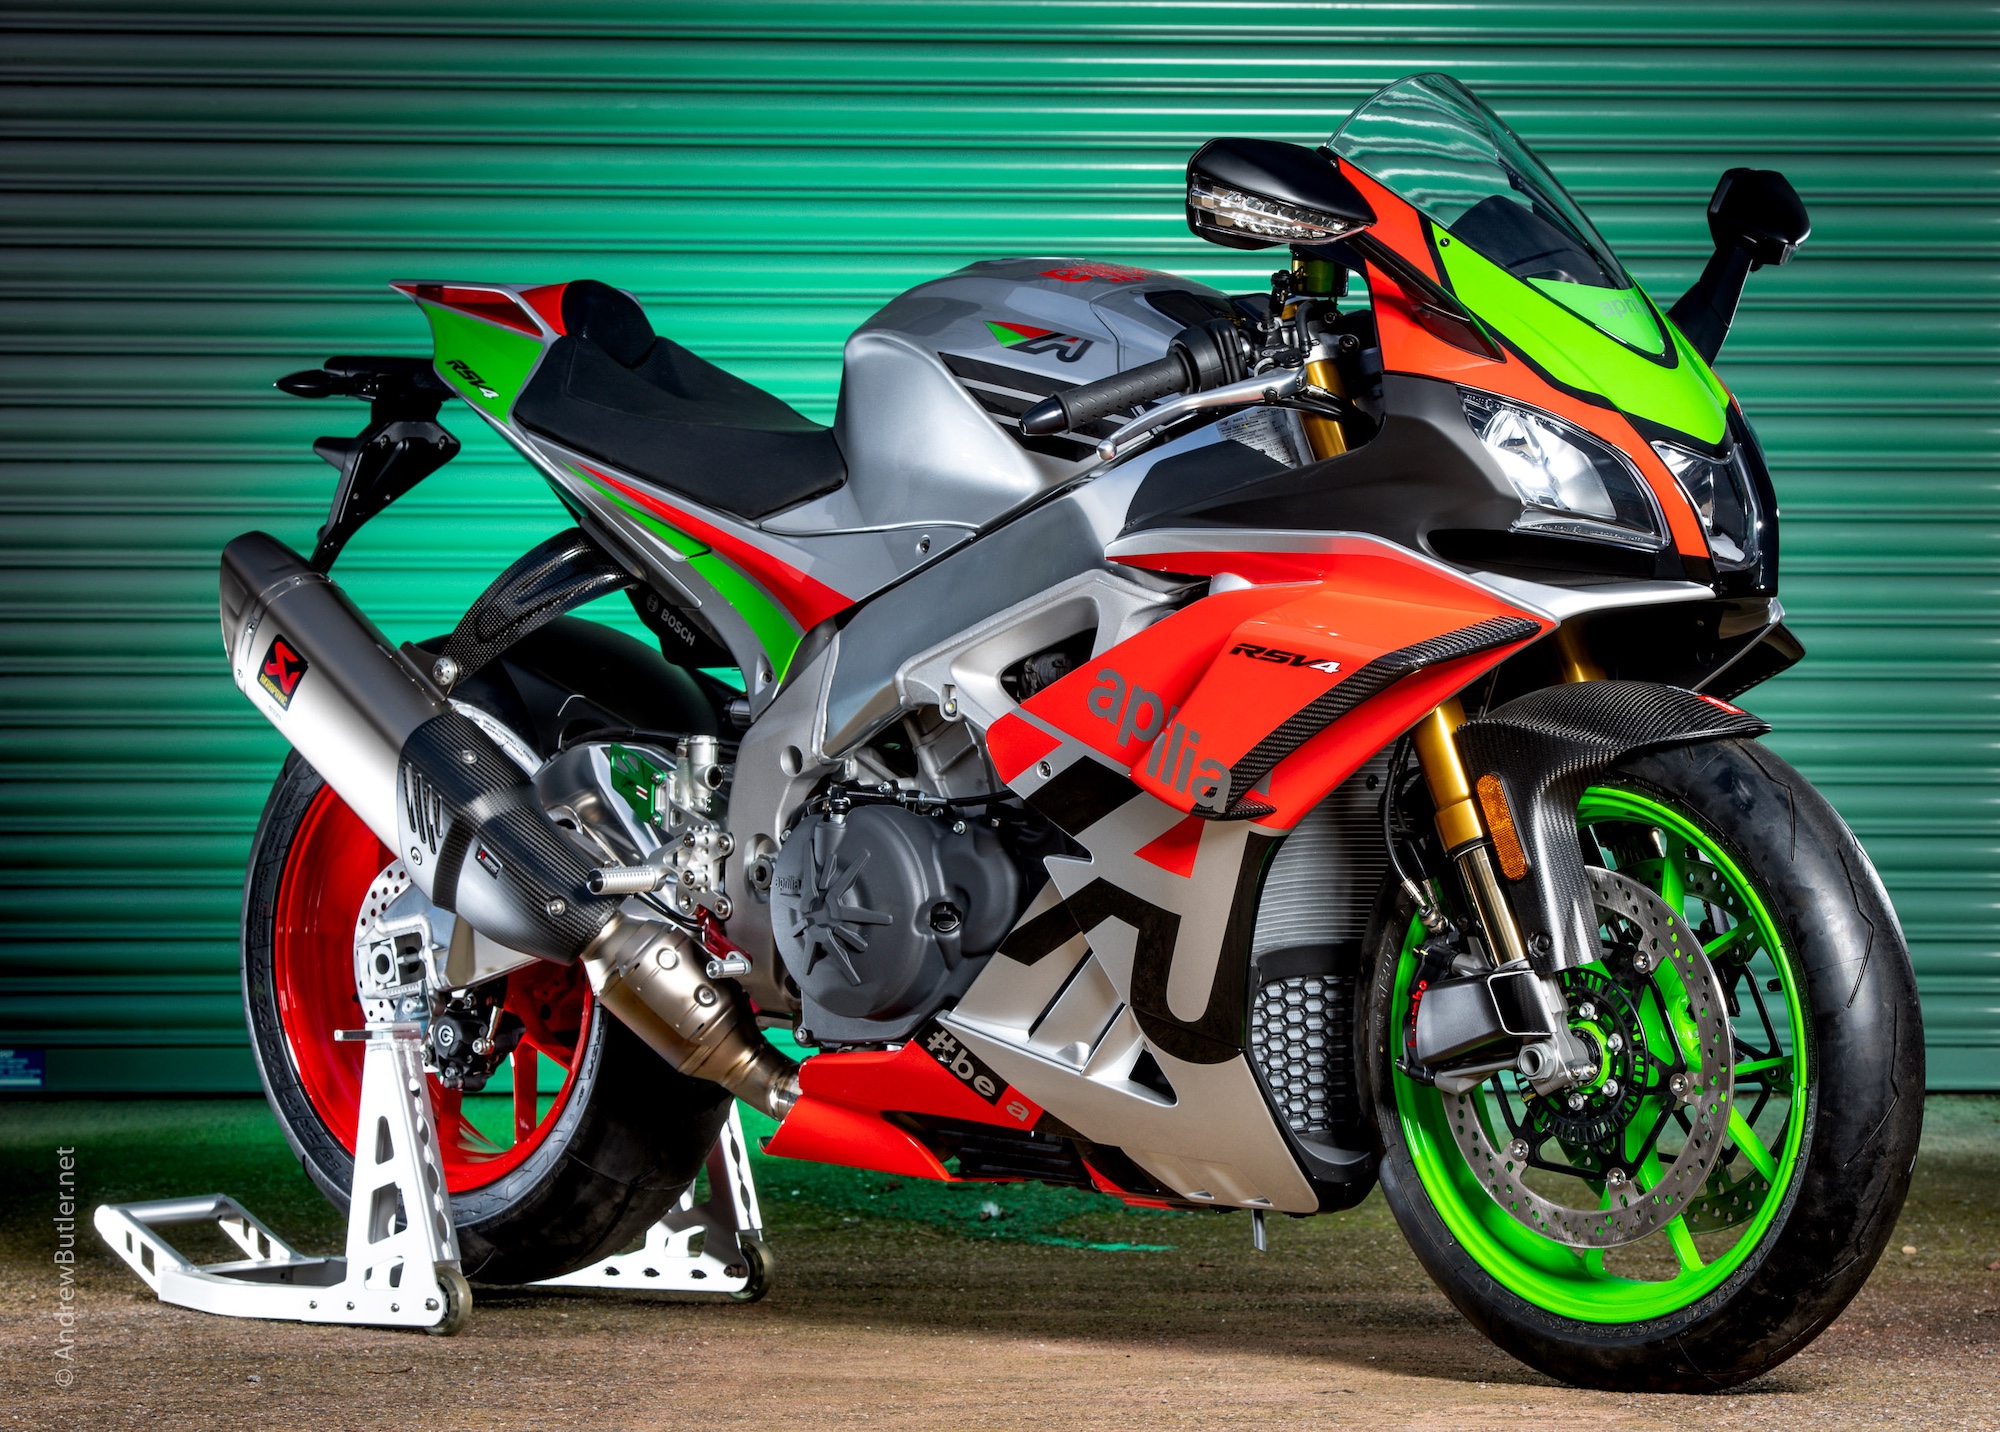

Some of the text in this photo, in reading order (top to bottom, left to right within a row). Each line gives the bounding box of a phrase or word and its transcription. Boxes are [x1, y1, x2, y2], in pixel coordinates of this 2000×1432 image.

[444, 359, 500, 399] RSV4
[661, 608, 696, 647] BOSCH
[1229, 642, 1342, 674] RSV4
[926, 1030, 1029, 1122] #be a
